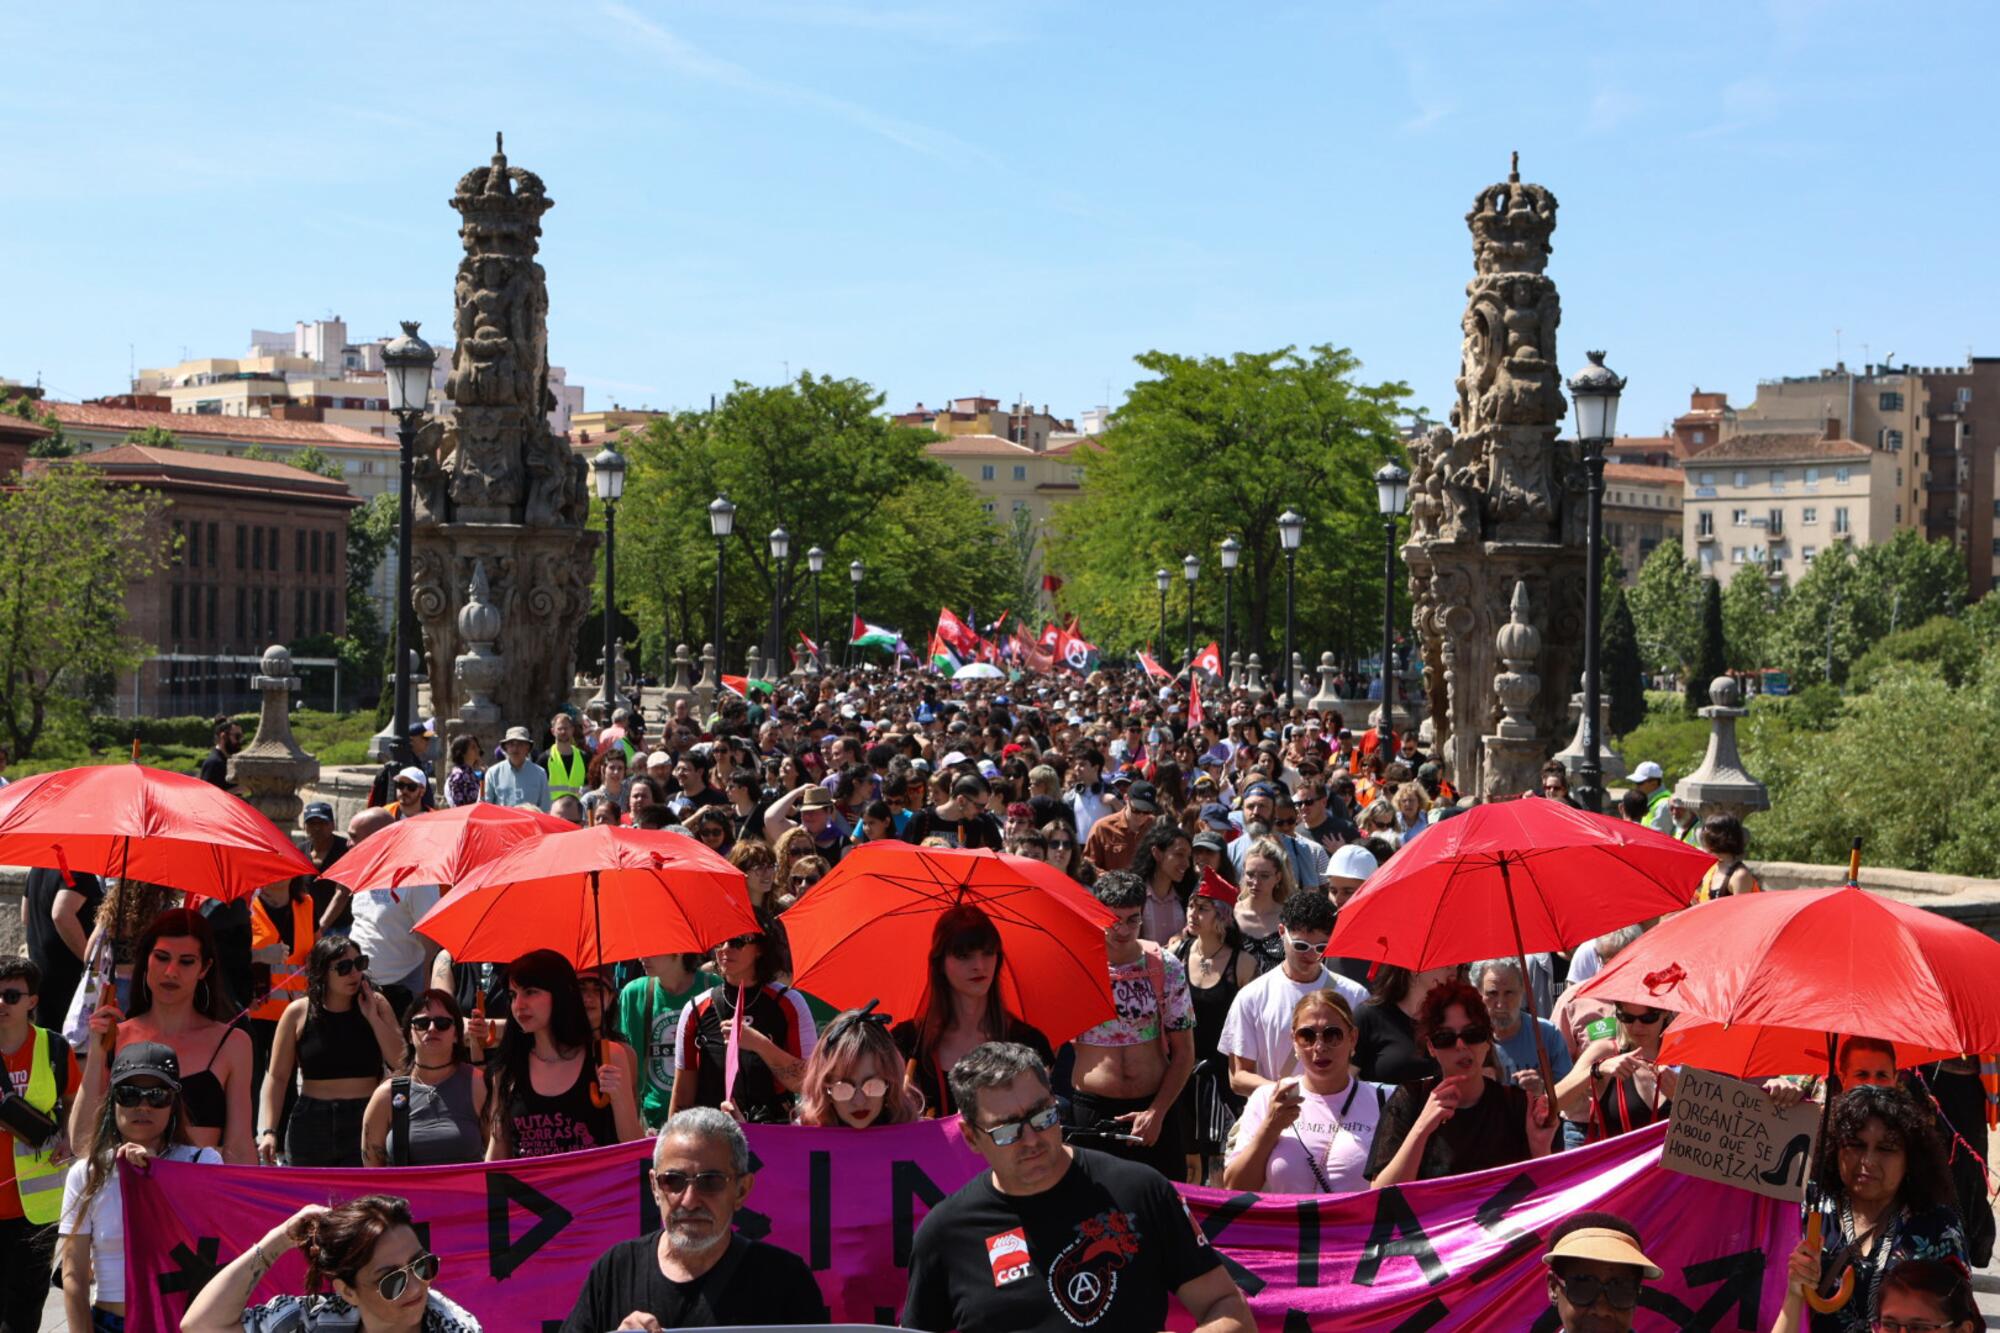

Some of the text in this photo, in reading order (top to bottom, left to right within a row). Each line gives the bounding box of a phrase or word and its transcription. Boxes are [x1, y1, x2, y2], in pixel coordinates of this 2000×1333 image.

[1681, 1074, 1790, 1121] PUTA QUE SE
[513, 1111, 563, 1130] PUTAS
[520, 1126, 573, 1140] ZORRAS
[1307, 1122, 1325, 1133] ME
[1328, 1121, 1372, 1134] RIGHTS
[1676, 1098, 1770, 1141] ORGANIZA
[1672, 1122, 1774, 1162] ABOLO QUE SE
[1668, 1139, 1762, 1185] HORRORIZA
[996, 1262, 1030, 1284] CGT
